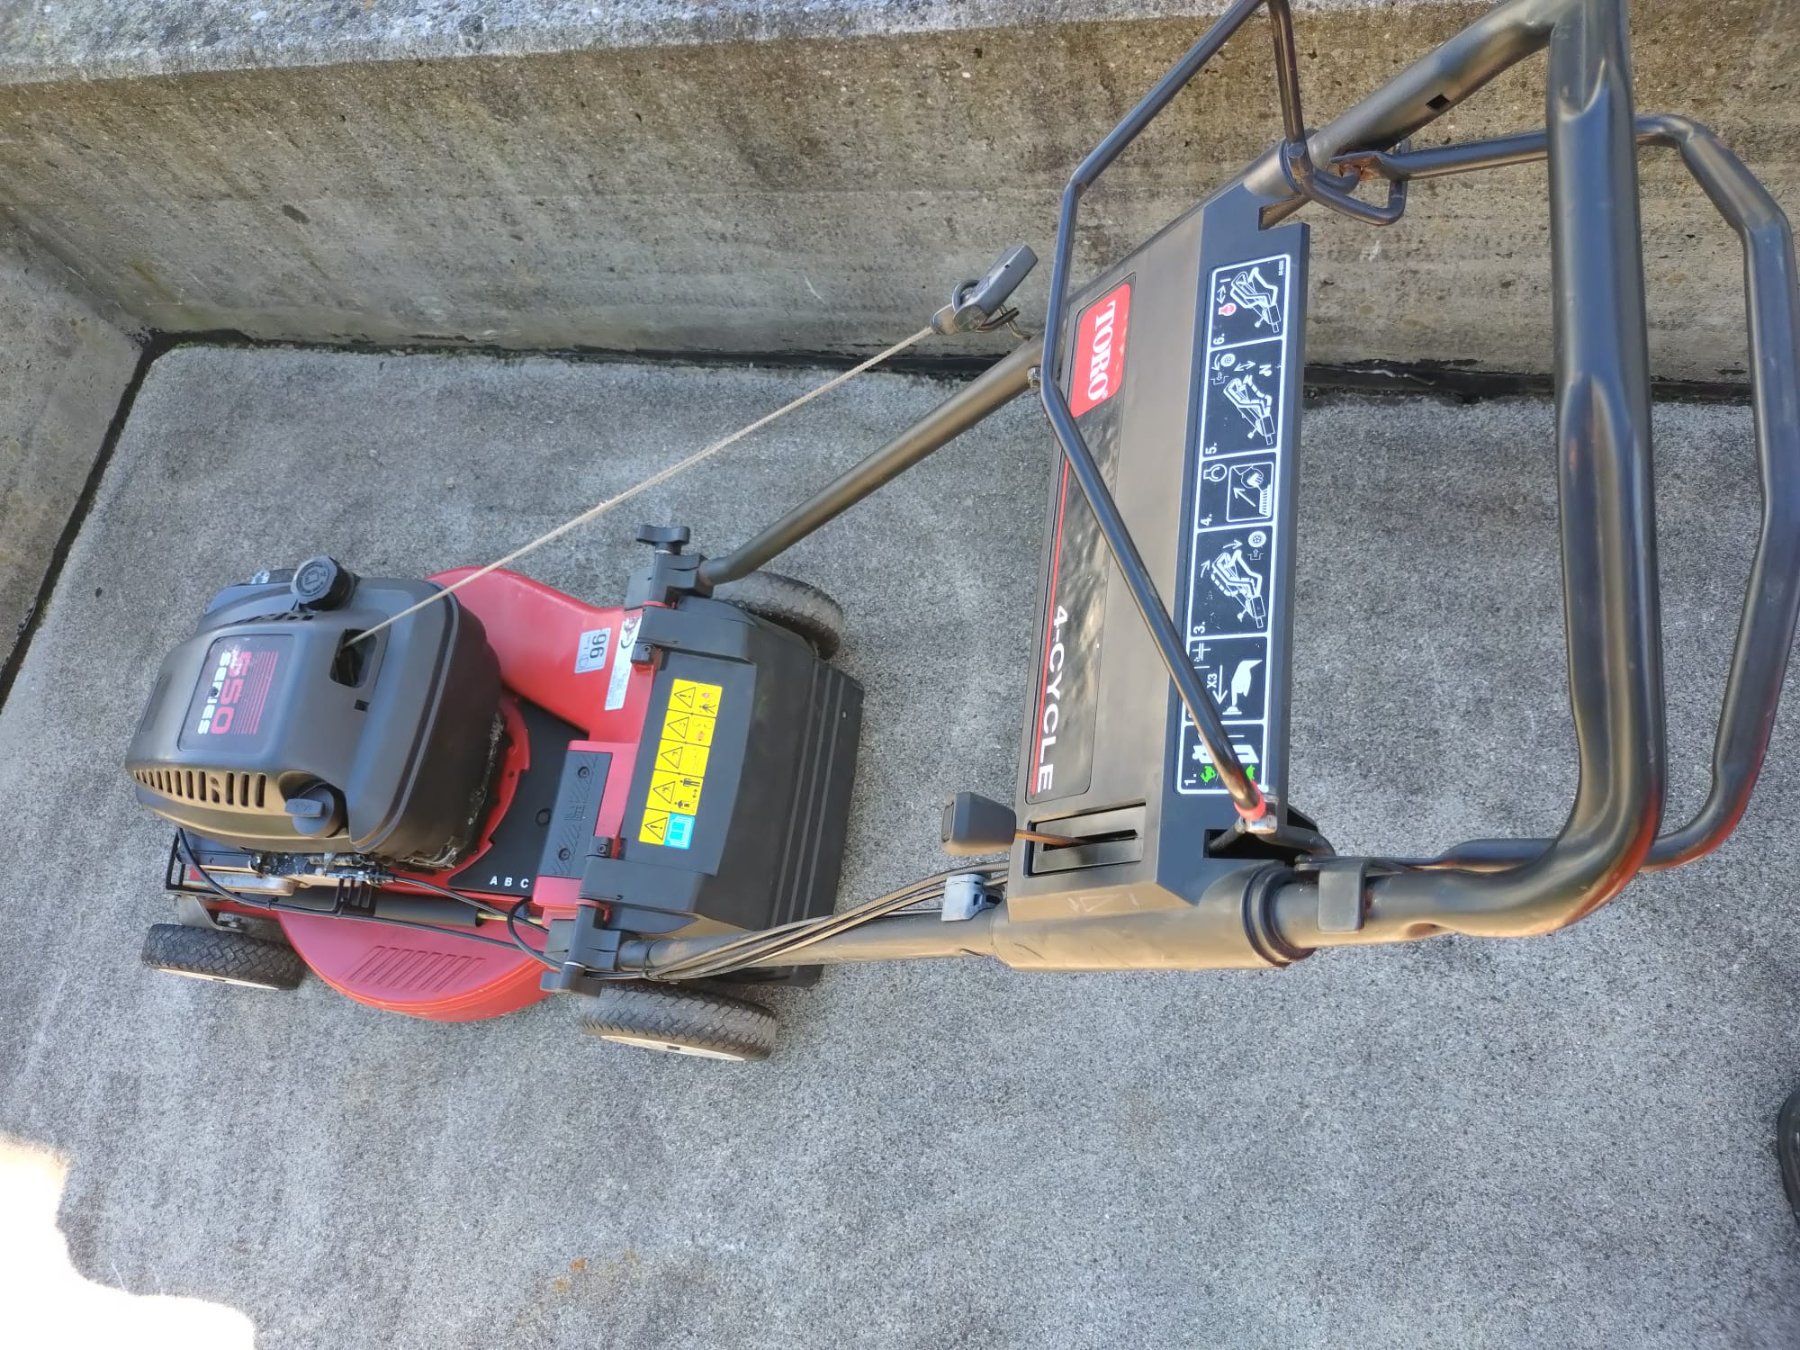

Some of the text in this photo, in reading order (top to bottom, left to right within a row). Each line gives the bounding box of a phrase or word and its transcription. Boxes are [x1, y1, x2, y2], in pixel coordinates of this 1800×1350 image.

[1088, 300, 1116, 400] TORO
[1205, 442, 1218, 454] 5.
[1200, 513, 1213, 526] 4.
[1193, 621, 1206, 634] 3.
[589, 633, 607, 659] 96
[1207, 672, 1218, 688] X3
[1037, 605, 1068, 793] 4-CYCLE
[489, 875, 530, 889] A B C
